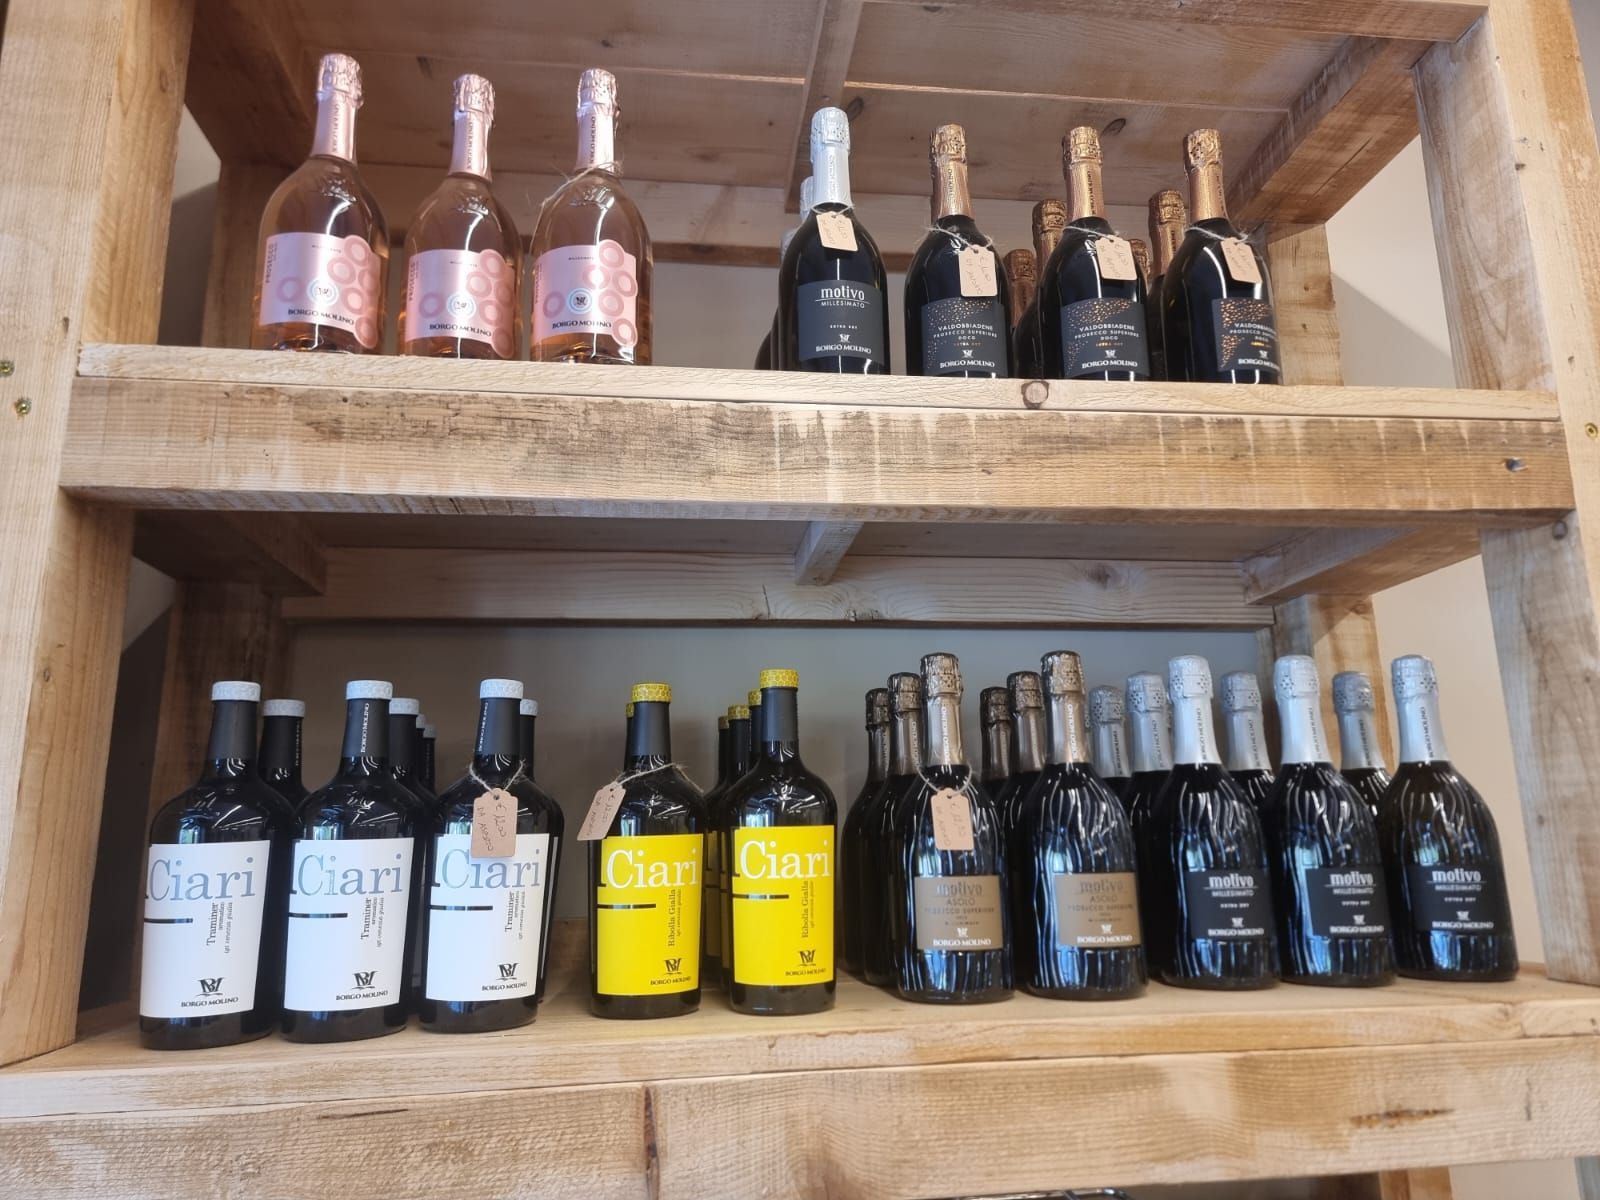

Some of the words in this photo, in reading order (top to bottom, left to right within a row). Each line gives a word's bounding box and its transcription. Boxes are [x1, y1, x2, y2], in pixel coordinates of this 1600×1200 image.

[821, 285, 865, 301] motivo
[821, 300, 865, 309] MILLESIMATO
[288, 308, 319, 316] BORGO
[321, 312, 354, 325] MOLINO
[429, 323, 458, 331] BORGO
[460, 325, 491, 337] MOLINO
[552, 320, 578, 330] BORGO
[938, 323, 994, 332] VALDOBBIADENE
[1079, 323, 1135, 332] VALDOBBIADENE
[933, 329, 965, 339] PROSECCO
[1074, 330, 1107, 340] PROSECCO
[816, 343, 843, 353] BORGO
[843, 344, 872, 354] MOLINO
[939, 360, 966, 369] BORGO
[967, 359, 995, 368] MOLINO
[1081, 359, 1109, 369] BORGO
[1109, 359, 1138, 367] MOLINO
[362, 703, 370, 730] MOLINO
[496, 802, 507, 812] €
[740, 839, 832, 880] Ciari
[297, 853, 403, 896] Ciari
[441, 849, 541, 889] Ciari
[606, 846, 699, 889] Ciari
[150, 857, 256, 901] Ciari
[1208, 873, 1254, 888] motivo
[1329, 871, 1374, 885] motivo
[1431, 868, 1482, 882] motivo
[936, 881, 983, 896] motivo
[668, 889, 676, 915] Gialla
[946, 898, 976, 906] ASOLO
[360, 897, 372, 940] Traminer
[504, 892, 515, 933] Traminer
[206, 902, 219, 946] Traminer
[801, 908, 809, 938] Ribolla
[1431, 920, 1462, 929] BORGO
[1463, 921, 1495, 929] MOLINO
[667, 917, 675, 947] Ribolla
[1207, 928, 1237, 937] BORGO
[1237, 927, 1265, 936] MOLINO
[933, 938, 960, 946] BORGO
[960, 938, 991, 946] MOLINO
[1077, 935, 1106, 944] BORGO
[1106, 935, 1133, 943] MOLINO
[208, 997, 239, 1007] MOLINO
[335, 993, 362, 1001] BORGO
[362, 990, 388, 999] MOLINO
